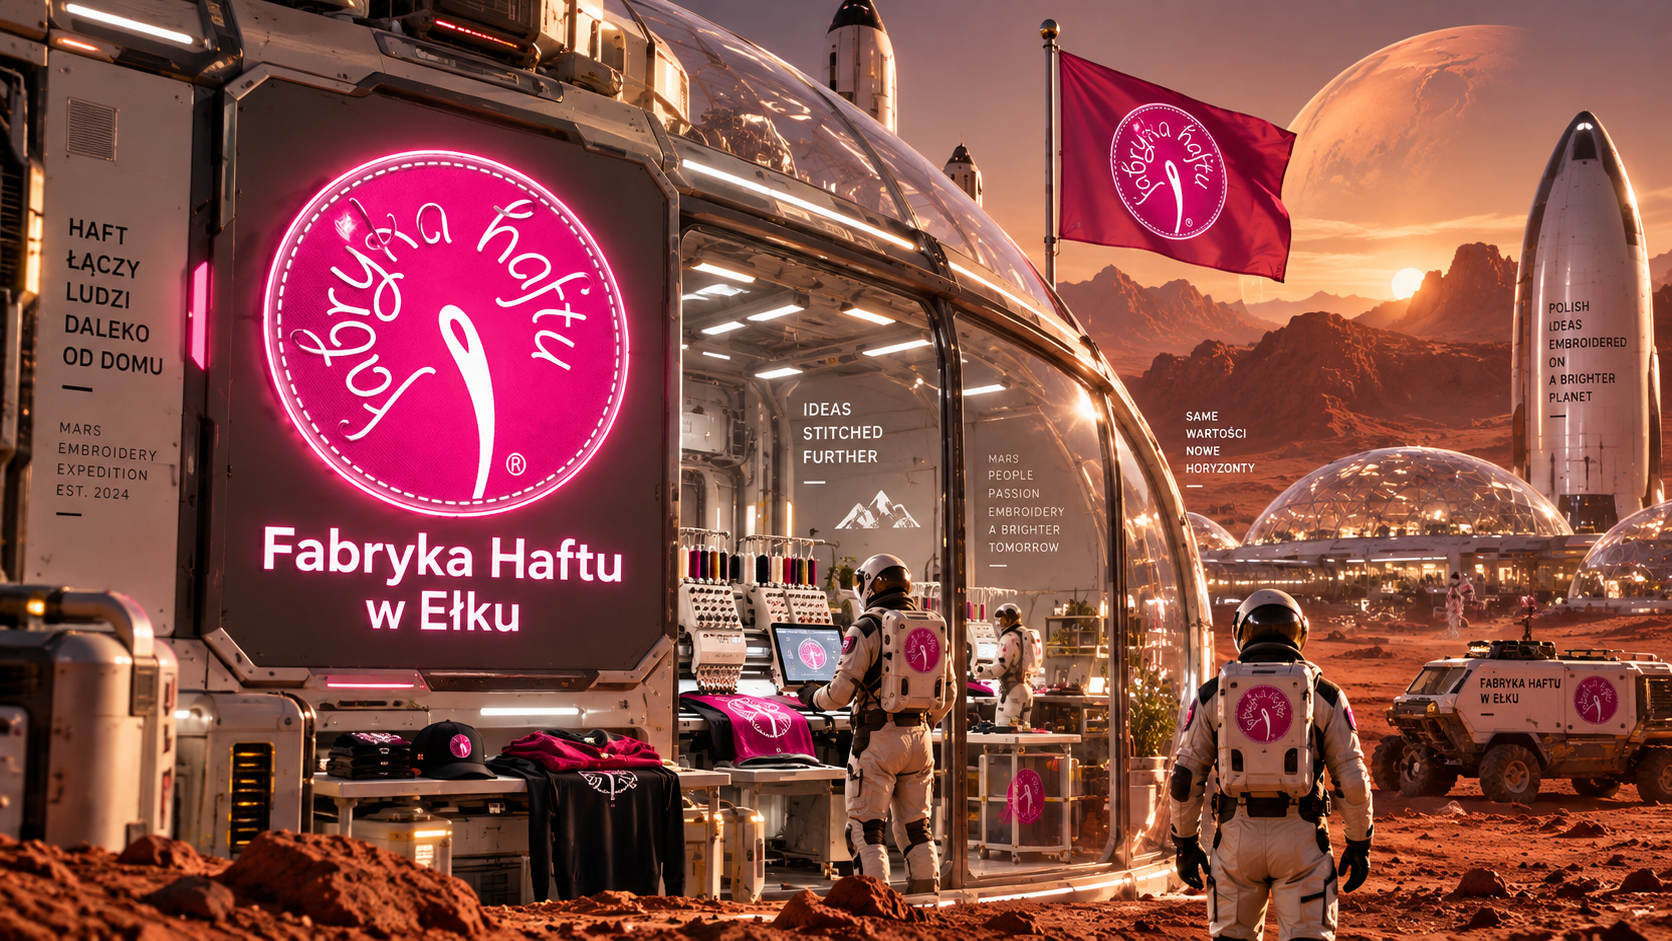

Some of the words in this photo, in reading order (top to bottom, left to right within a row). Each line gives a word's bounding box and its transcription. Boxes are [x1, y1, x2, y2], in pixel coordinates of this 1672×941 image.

[68, 217, 128, 245] HAFT
[66, 249, 141, 279] ŁĄCZY
[477, 199, 594, 371] haftu
[66, 281, 130, 310] LUDZI
[1548, 300, 1590, 314] POLISH
[64, 313, 150, 343] DALEKO
[1549, 318, 1583, 332] IDEAS
[1549, 336, 1628, 350] EMBROIDERED
[62, 346, 94, 367] OD
[101, 350, 163, 376] DOMU
[1548, 356, 1565, 368] ON
[1548, 374, 1557, 386] A
[1560, 372, 1616, 385] BRIGHTER
[1549, 390, 1593, 403] PLANET
[803, 402, 852, 417] IDEAS
[59, 421, 101, 437] MARS
[803, 425, 883, 441] STITCHED
[58, 442, 157, 462] EMBROIDERY
[803, 449, 878, 464] FURTHER
[988, 453, 1019, 464] MARS
[57, 462, 148, 481] EXPEDITION
[988, 469, 1033, 481] PEOPLE
[56, 483, 88, 498] EST.
[93, 486, 130, 500] 2024
[988, 488, 1040, 499] PASSION
[988, 506, 1065, 517] EMBROIDERY
[988, 524, 997, 535] A
[1001, 524, 1060, 535] BRIGHTER
[988, 541, 1059, 553] TOMORROW
[263, 526, 473, 587] Fabryka
[491, 536, 622, 583] Haftu
[365, 599, 406, 630] w
[420, 589, 520, 632] Ełku
[1480, 677, 1526, 689] FABRYKA
[1528, 677, 1561, 689] HAFTU
[1480, 693, 1490, 704] W
[1493, 693, 1519, 704] EŁKU
